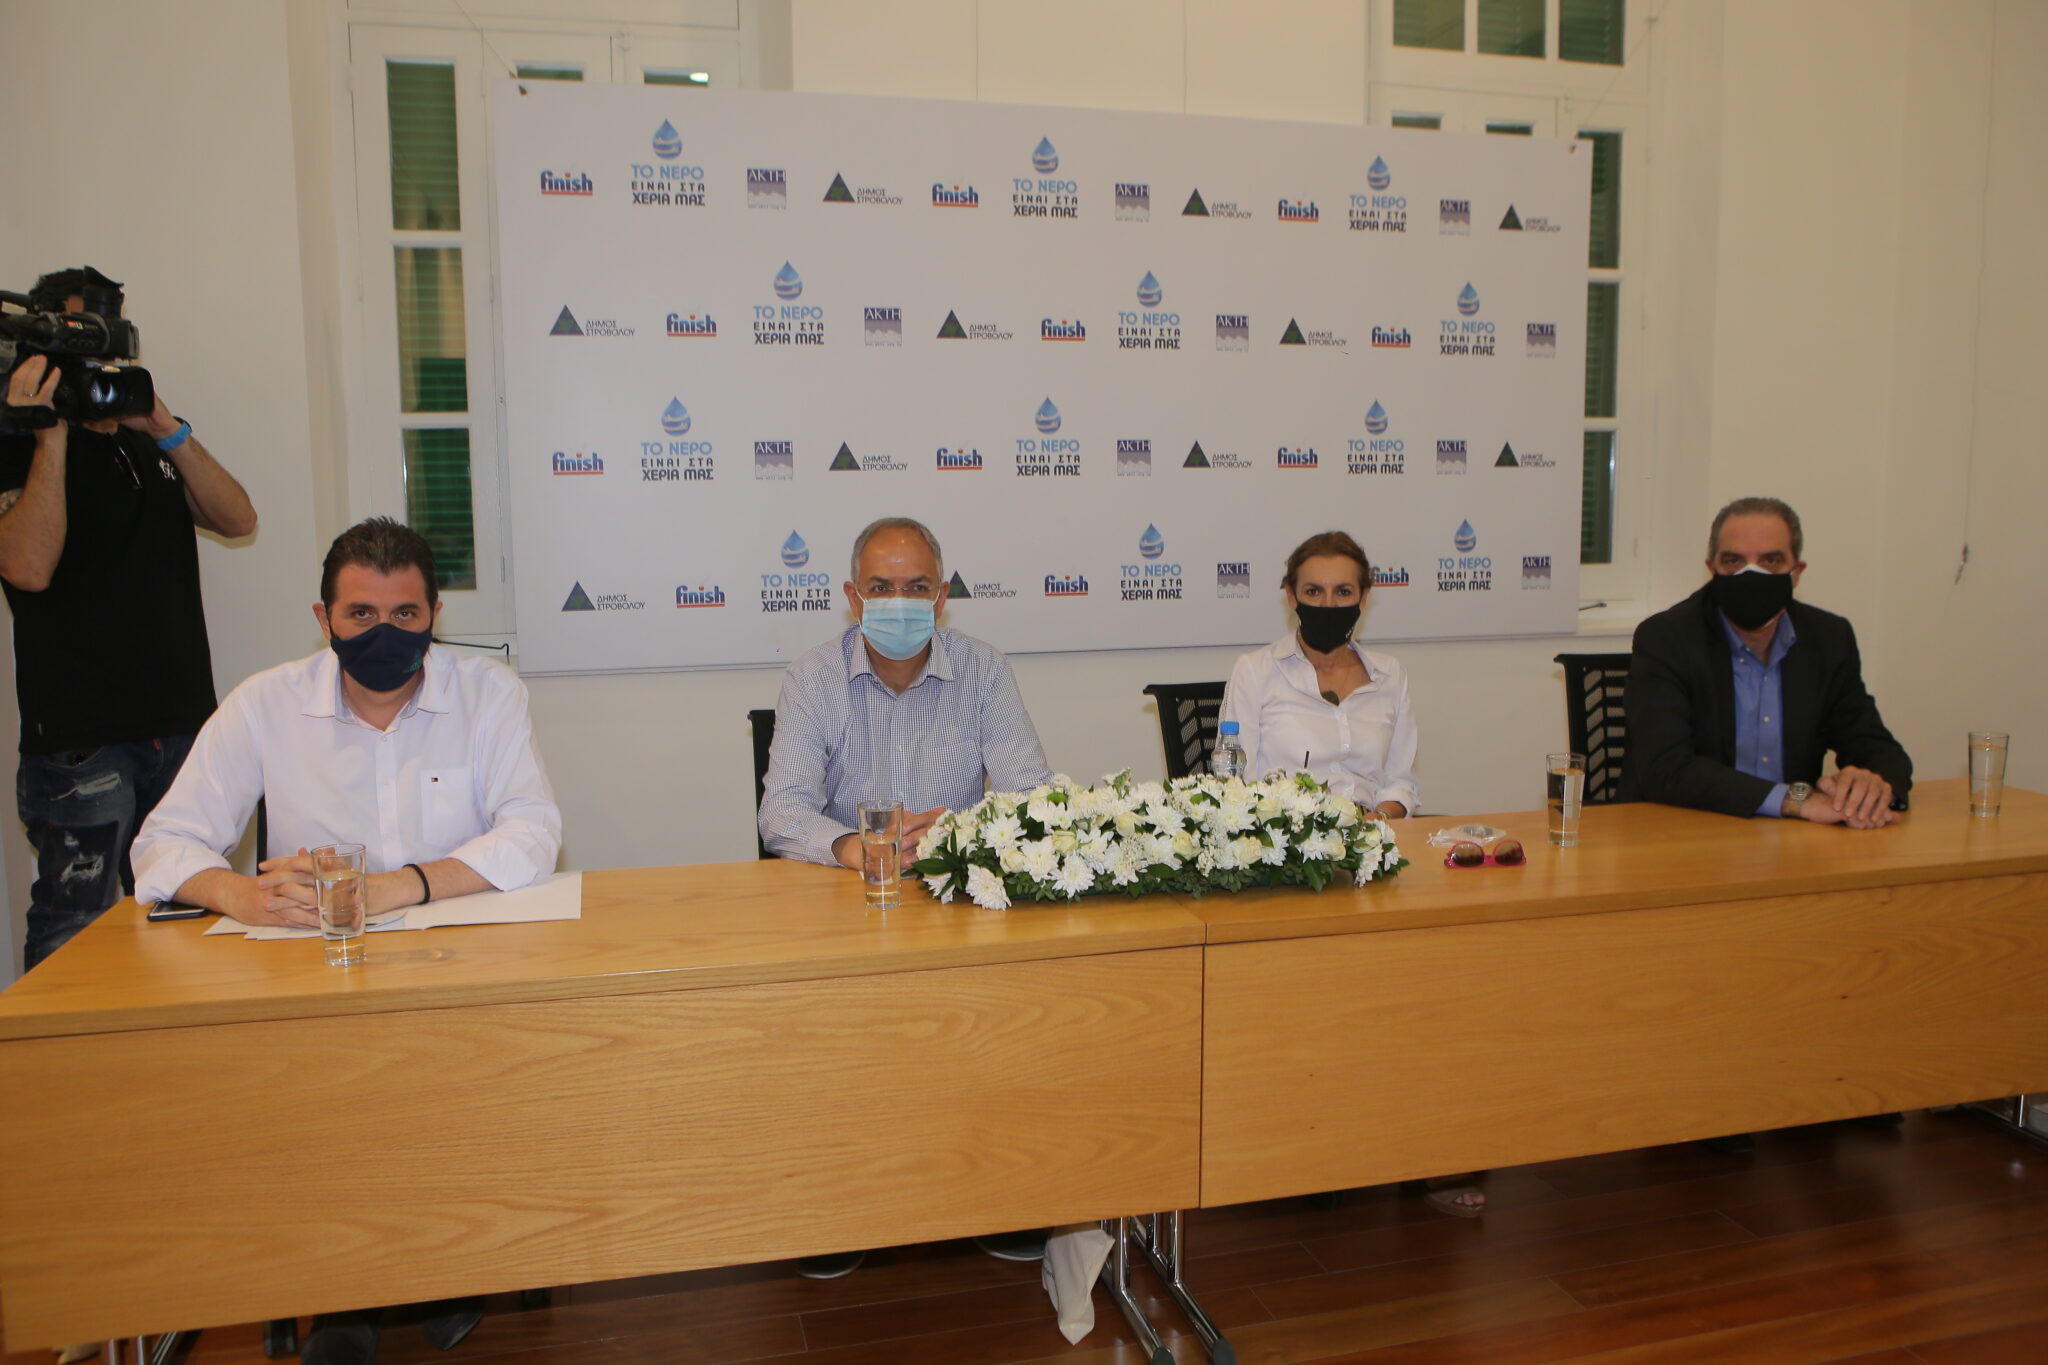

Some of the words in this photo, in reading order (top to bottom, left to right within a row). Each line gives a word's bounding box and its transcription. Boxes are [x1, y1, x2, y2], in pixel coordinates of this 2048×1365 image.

[631, 164, 653, 178] ΤΟ
[660, 165, 704, 180] ΝΕΡΟ
[748, 169, 786, 182] ΑΚΤΗ
[540, 170, 593, 192] finish
[631, 181, 670, 192] ΕΙΝΑΙ
[680, 182, 705, 192] ΣΤΑ
[1013, 179, 1033, 192] ΤΟ
[1038, 180, 1077, 193] ΝΕΡΟ
[932, 183, 978, 203] finish
[1116, 183, 1150, 195] ΑΚΤΗ
[633, 192, 670, 205] ΧΕΡΙΑ
[675, 193, 705, 206] ΜΑΣ
[857, 195, 903, 205] ΣΤΡΟΒΟΛΟΥ
[1013, 195, 1047, 206] ΕΙΝΑΙ
[1056, 195, 1078, 205] ΣΤΑ
[1350, 195, 1367, 210] ΤΟ
[1371, 196, 1406, 211] ΝΕΡΟ
[1014, 206, 1047, 217] ΧΕΡΙΑ
[1051, 206, 1078, 218] ΜΑΣ
[1278, 199, 1319, 218] finish
[753, 306, 775, 319] ΤΟ
[781, 306, 823, 320] ΝΕΡΟ
[865, 308, 902, 321] ΑΚΤΗ
[1119, 312, 1137, 325] ΤΟ
[1143, 313, 1180, 326] ΝΕΡΟ
[666, 312, 717, 333] finish
[754, 321, 791, 331] ΕΙΝΑΙ
[800, 322, 824, 332] ΣΤΑ
[1217, 315, 1249, 326] ΑΚΤΗ
[1441, 320, 1457, 332] ΤΟ
[1462, 321, 1495, 334] ΝΕΡΟ
[586, 328, 635, 336] ΣΤΡΟΒΟΛΟΥ
[969, 324, 997, 332] ΔΗΜΟΣ
[1041, 318, 1085, 337] finish
[1118, 327, 1151, 338] ΕΙΝΑΙ
[1158, 328, 1180, 338] ΣΤΑ
[754, 332, 790, 344] ΧΕΡΙΑ
[795, 332, 824, 345] ΜΑΣ
[969, 332, 1013, 340] ΣΤΡΟΒΟΛΟΥ
[1372, 326, 1411, 344] finish
[1119, 337, 1151, 349] ΧΕΡΙΑ
[1155, 337, 1180, 350] ΜΑΣ
[641, 442, 663, 455] ΤΟ
[669, 442, 712, 455] ΝΕΡΟ
[754, 441, 793, 453] ΑΚΤΗ
[1016, 440, 1036, 452] ΤΟ
[1041, 440, 1080, 452] ΝΕΡΟ
[1118, 440, 1151, 451] ΑΚΤΗ
[1348, 440, 1365, 451] ΤΟ
[1370, 440, 1404, 452] ΝΕΡΟ
[552, 451, 604, 471] finish
[936, 447, 983, 467] finish
[1016, 454, 1050, 464] ΕΙΝΑΙ
[1058, 454, 1080, 463] ΣΤΑ
[1278, 446, 1318, 465] finish
[641, 458, 679, 468] ΕΙΝΑΙ
[689, 457, 713, 467] ΣΤΑ
[863, 463, 907, 471] ΣΤΡΟΒΟΛΟΥ
[642, 467, 679, 481] ΧΕΡΙΑ
[684, 468, 714, 480] ΜΑΣ
[1017, 463, 1050, 476] ΧΕΡΙΑ
[1054, 464, 1080, 476] ΜΑΣ
[1217, 563, 1250, 574] ΑΚΤΗ
[1438, 558, 1454, 569] ΤΟ
[1459, 557, 1491, 569] ΝΕΡΟ
[1121, 565, 1140, 577] ΤΟ
[1145, 564, 1182, 579] ΝΕΡΟ
[761, 574, 782, 587] ΤΟ
[788, 573, 829, 587] ΝΕΡΟ
[1045, 574, 1088, 592] finish
[1121, 579, 1153, 588] ΕΙΝΑΙ
[1161, 579, 1183, 589] ΣΤΑ
[761, 589, 798, 599] ΕΙΝΑΙ
[807, 588, 830, 598] ΣΤΑ
[973, 583, 1001, 591] ΔΗΜΟΣ
[597, 594, 627, 602] ΔΗΜΟΣ
[675, 585, 726, 604] finish
[973, 590, 1017, 599] ΣΤΡΟΒΟΛΟΥ
[1121, 589, 1153, 601] ΧΕΡΙΑ
[1157, 588, 1182, 600] ΜΑΣ
[597, 602, 645, 611] ΣΤΡΟΒΟΛΟΥ
[762, 600, 797, 612] ΧΕΡΙΑ
[802, 599, 830, 611] ΜΑΣ
